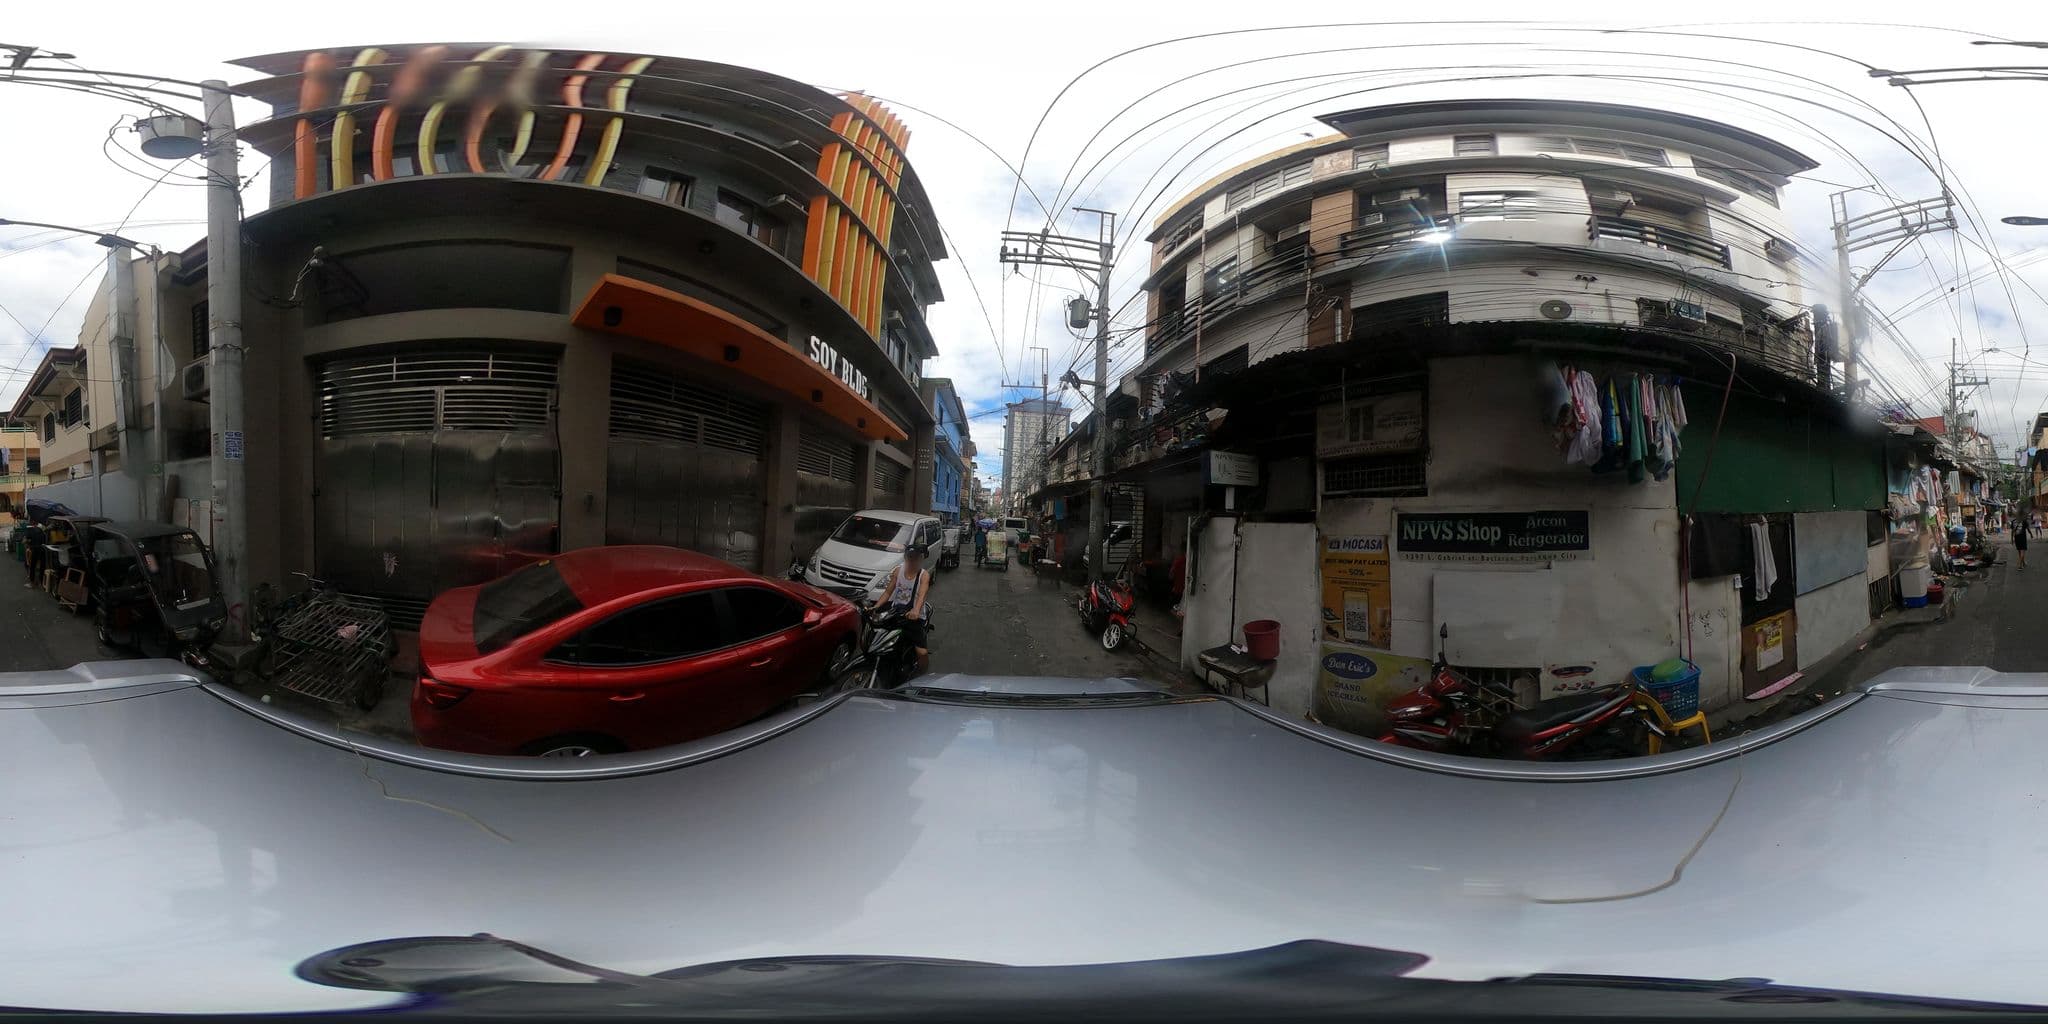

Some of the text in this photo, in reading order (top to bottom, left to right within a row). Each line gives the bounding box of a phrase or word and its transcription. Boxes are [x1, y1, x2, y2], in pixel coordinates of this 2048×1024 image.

[810, 335, 838, 375] SOY
[1342, 539, 1382, 550] MOCASA
[1403, 519, 1501, 546] NPVS Shop
